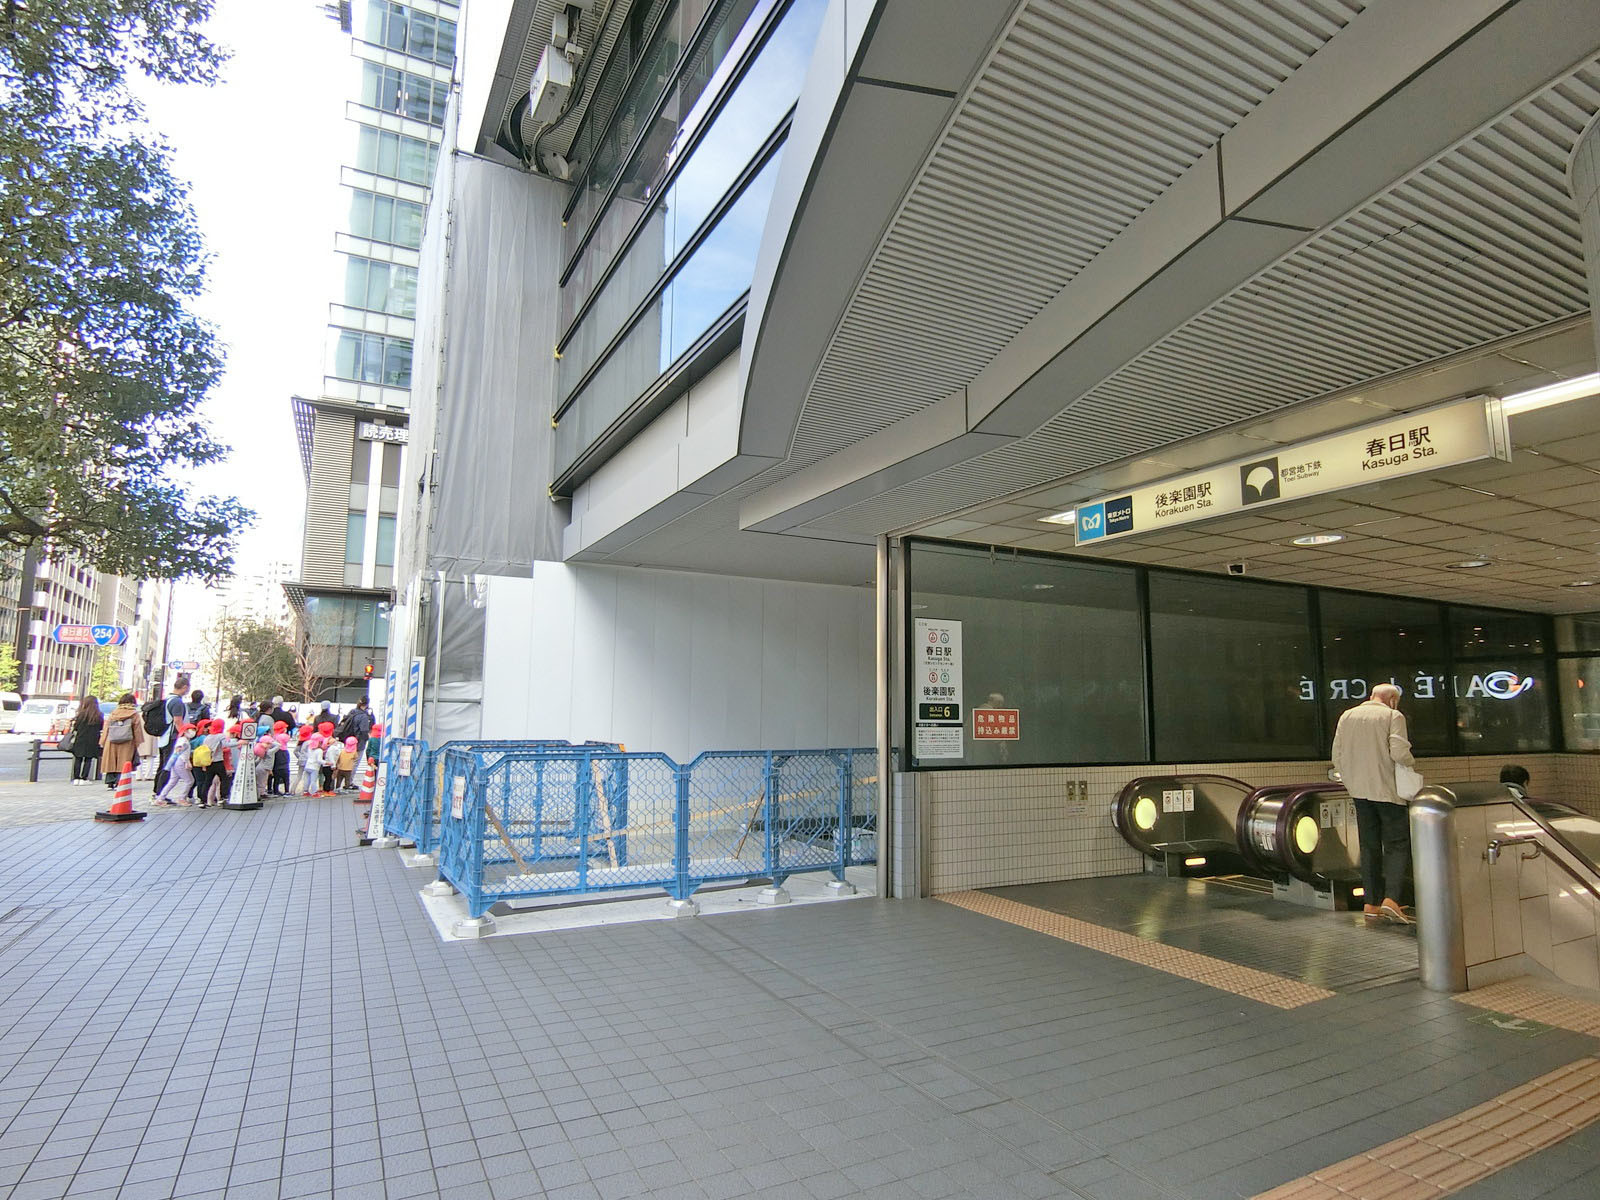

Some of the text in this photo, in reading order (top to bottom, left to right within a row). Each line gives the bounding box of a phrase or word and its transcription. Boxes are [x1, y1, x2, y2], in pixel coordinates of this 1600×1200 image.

[1366, 426, 1431, 457] 春日駅
[1362, 447, 1437, 471] Kasuga Sta.
[1280, 460, 1323, 477] 都営地下鉄
[1297, 471, 1319, 480] Subway
[1155, 481, 1212, 508] 後楽園駅
[1197, 499, 1213, 509] Sta.
[94, 628, 112, 639] 254
[926, 646, 952, 656] 春日駅
[923, 686, 956, 697] 後楽園駅
[943, 706, 951, 718] 6
